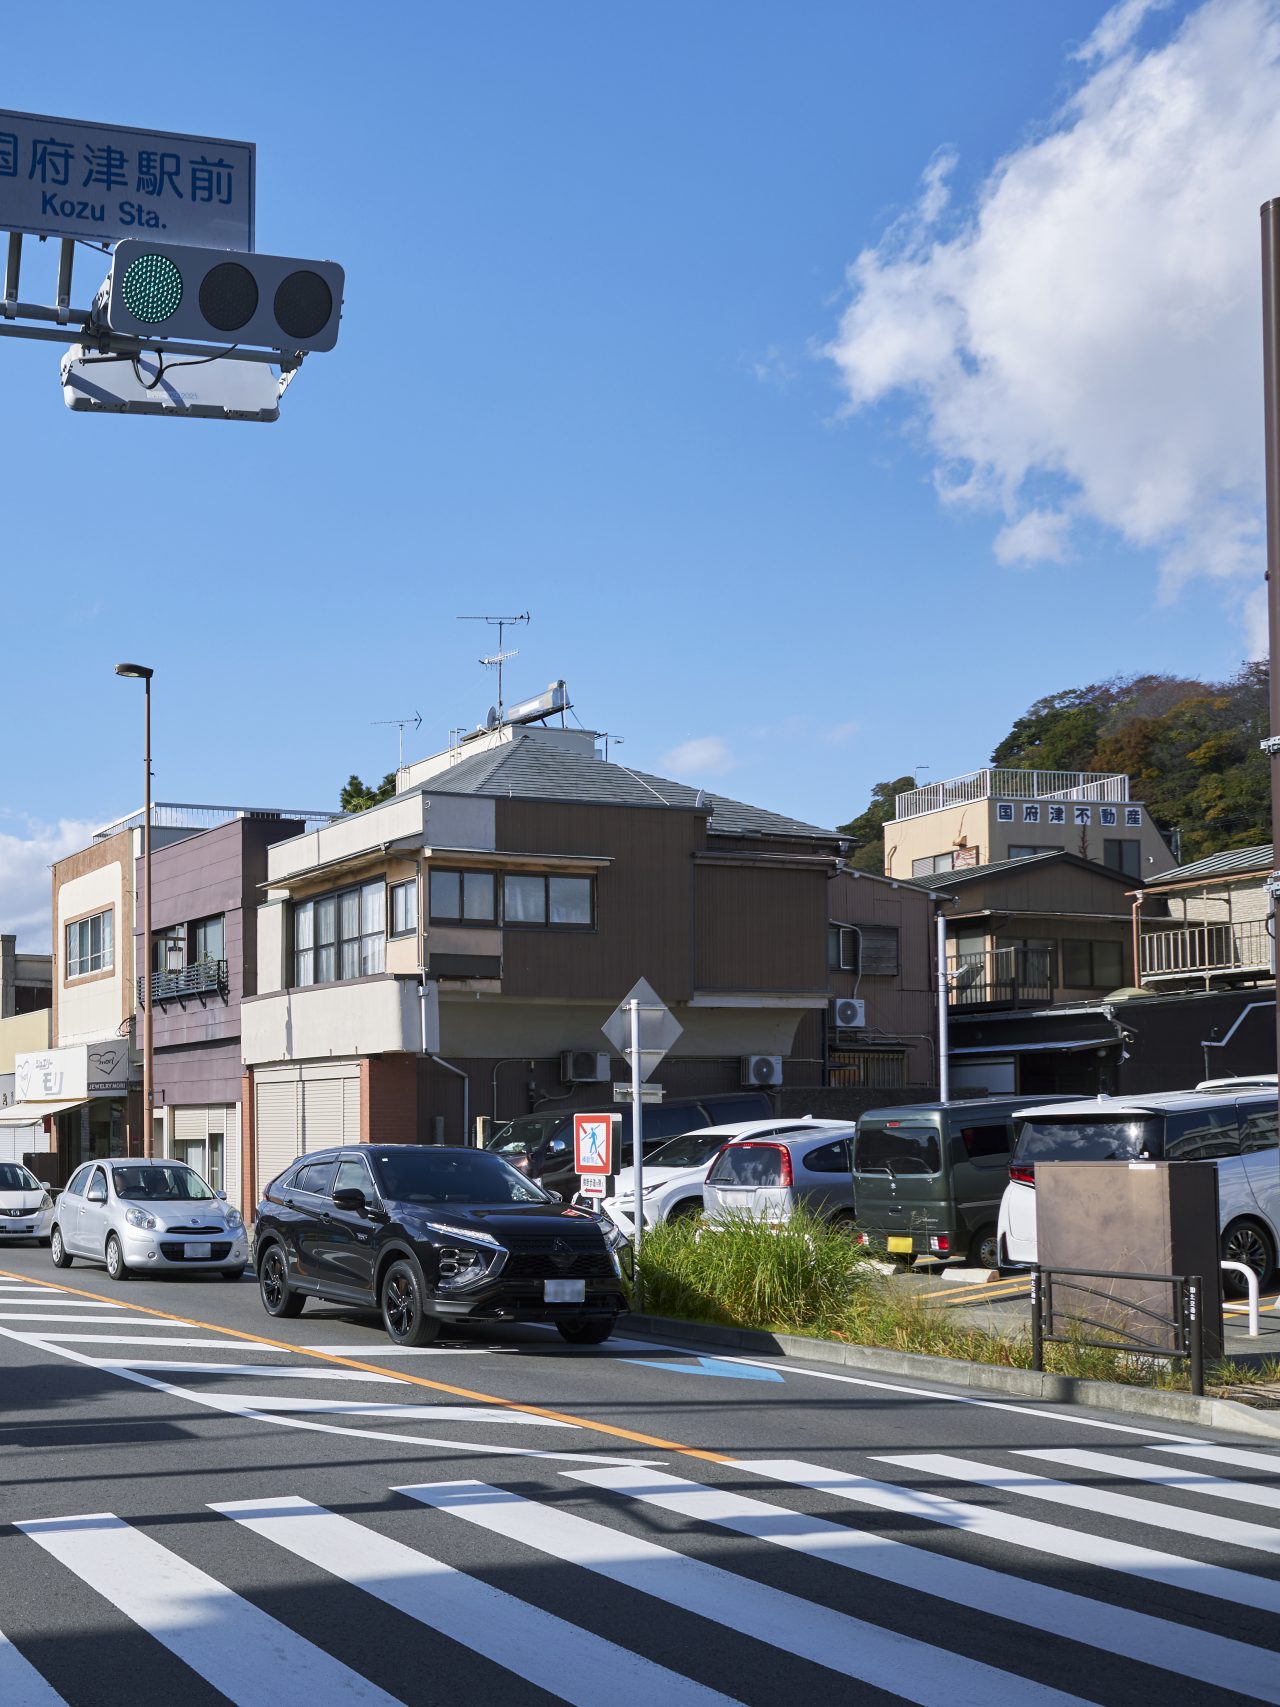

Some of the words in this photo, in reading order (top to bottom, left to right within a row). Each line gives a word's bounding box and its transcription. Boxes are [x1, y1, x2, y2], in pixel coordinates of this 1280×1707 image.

[40, 190, 106, 222] Kozu
[118, 201, 168, 230] Sta.
[998, 804, 1141, 825] 国府津不動産
